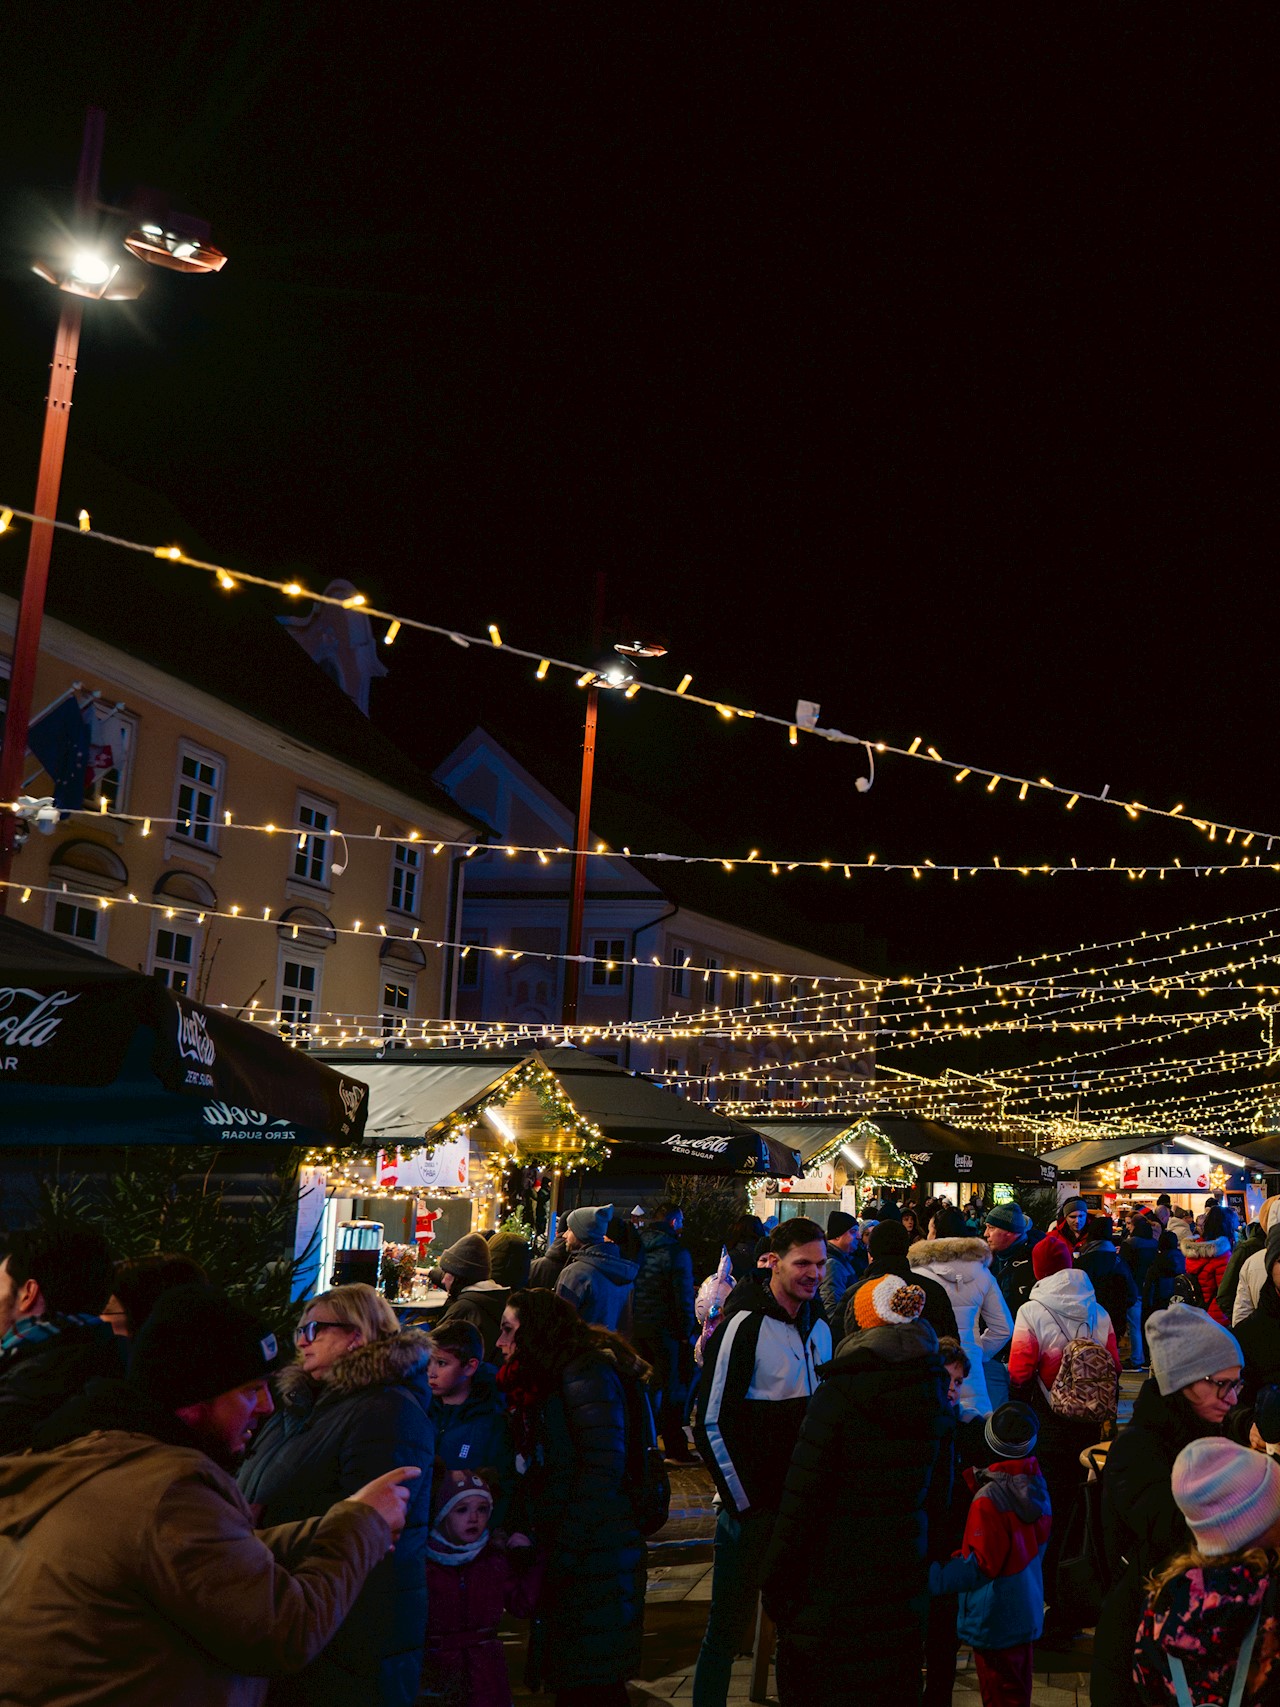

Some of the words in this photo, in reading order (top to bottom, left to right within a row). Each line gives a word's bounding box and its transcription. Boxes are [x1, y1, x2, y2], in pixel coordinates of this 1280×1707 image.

[672, 1145, 690, 1155] ZERO
[690, 1149, 714, 1160] SUGAR
[1147, 1166, 1191, 1178] FINESA
